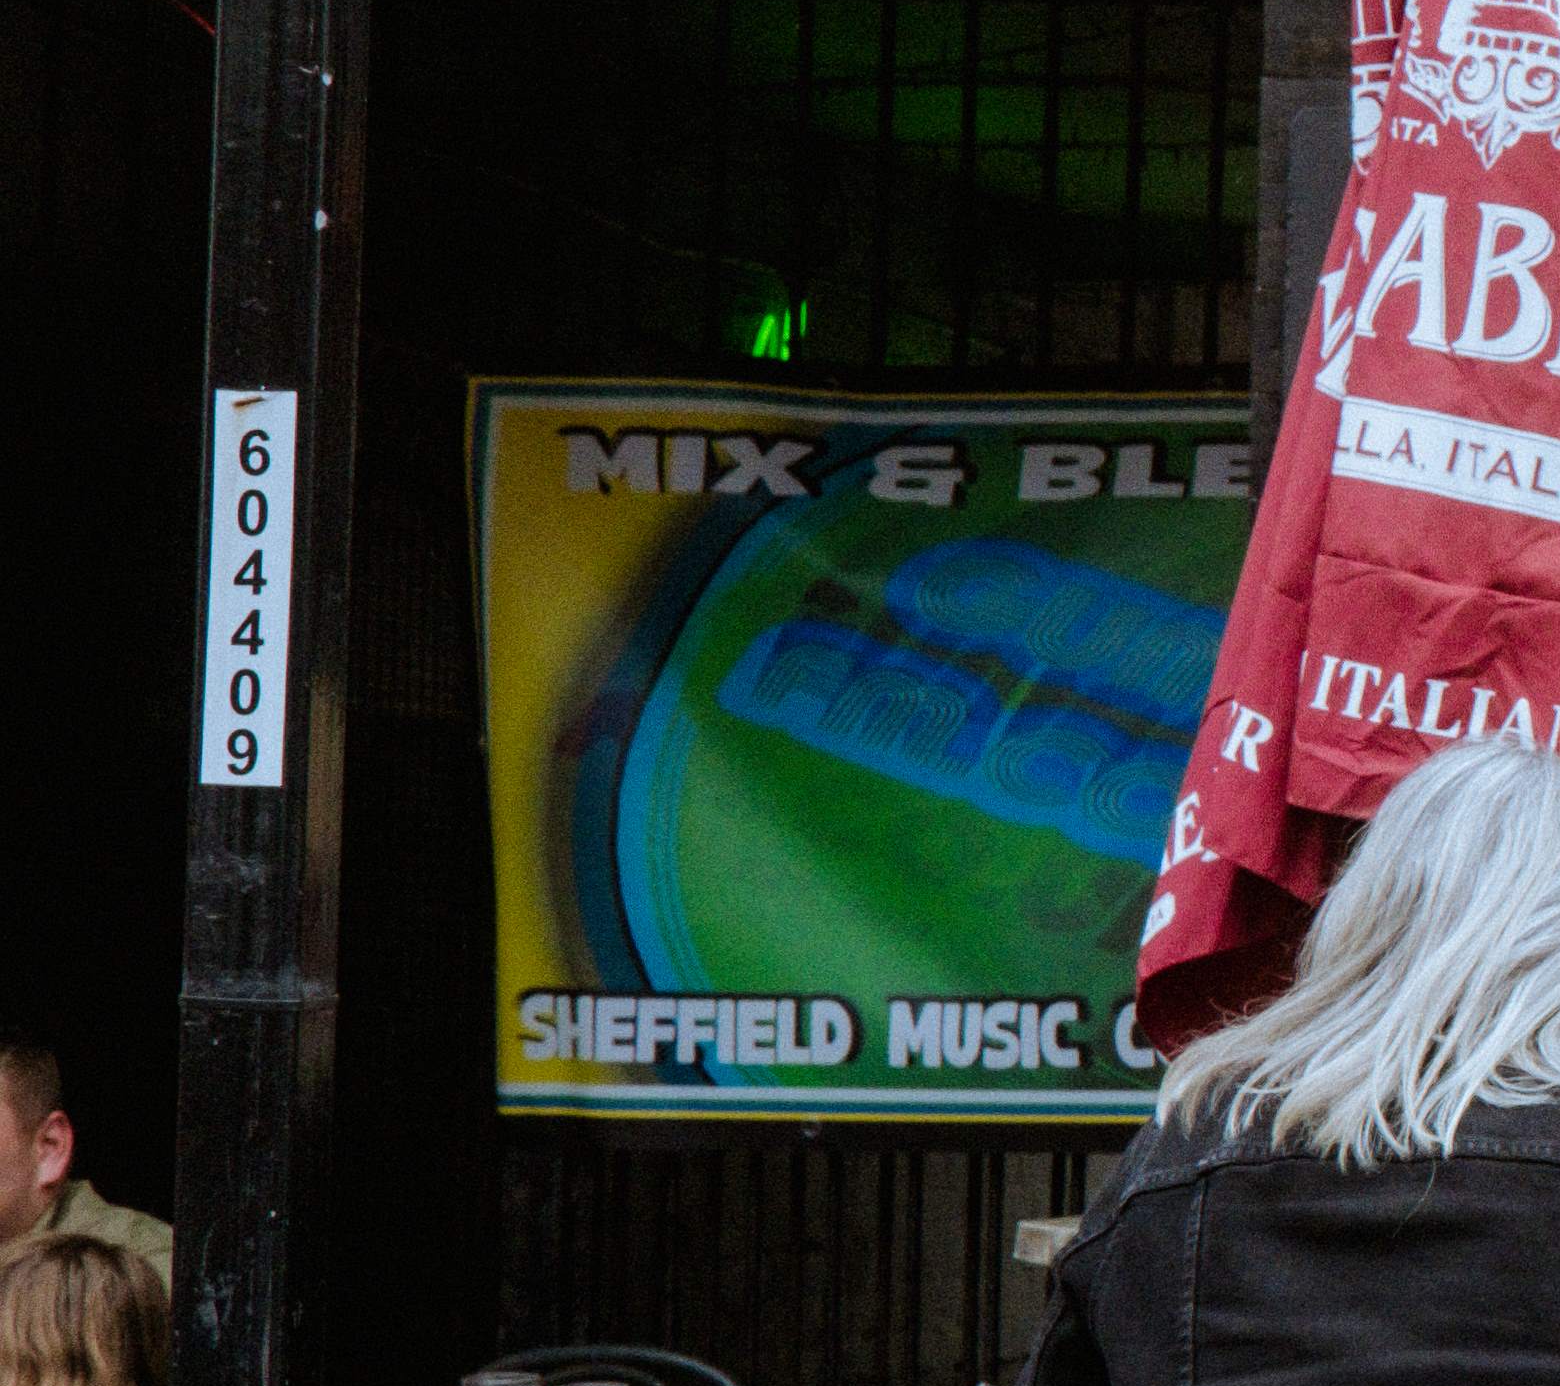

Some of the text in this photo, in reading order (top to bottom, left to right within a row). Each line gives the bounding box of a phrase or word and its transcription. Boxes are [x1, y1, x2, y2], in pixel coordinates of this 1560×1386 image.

[560, 428, 816, 499] MIX
[866, 443, 968, 508] &
[226, 429, 271, 777] 604409
[518, 993, 854, 1065] SHEFFIELD
[888, 999, 1081, 1070] MUSIC
